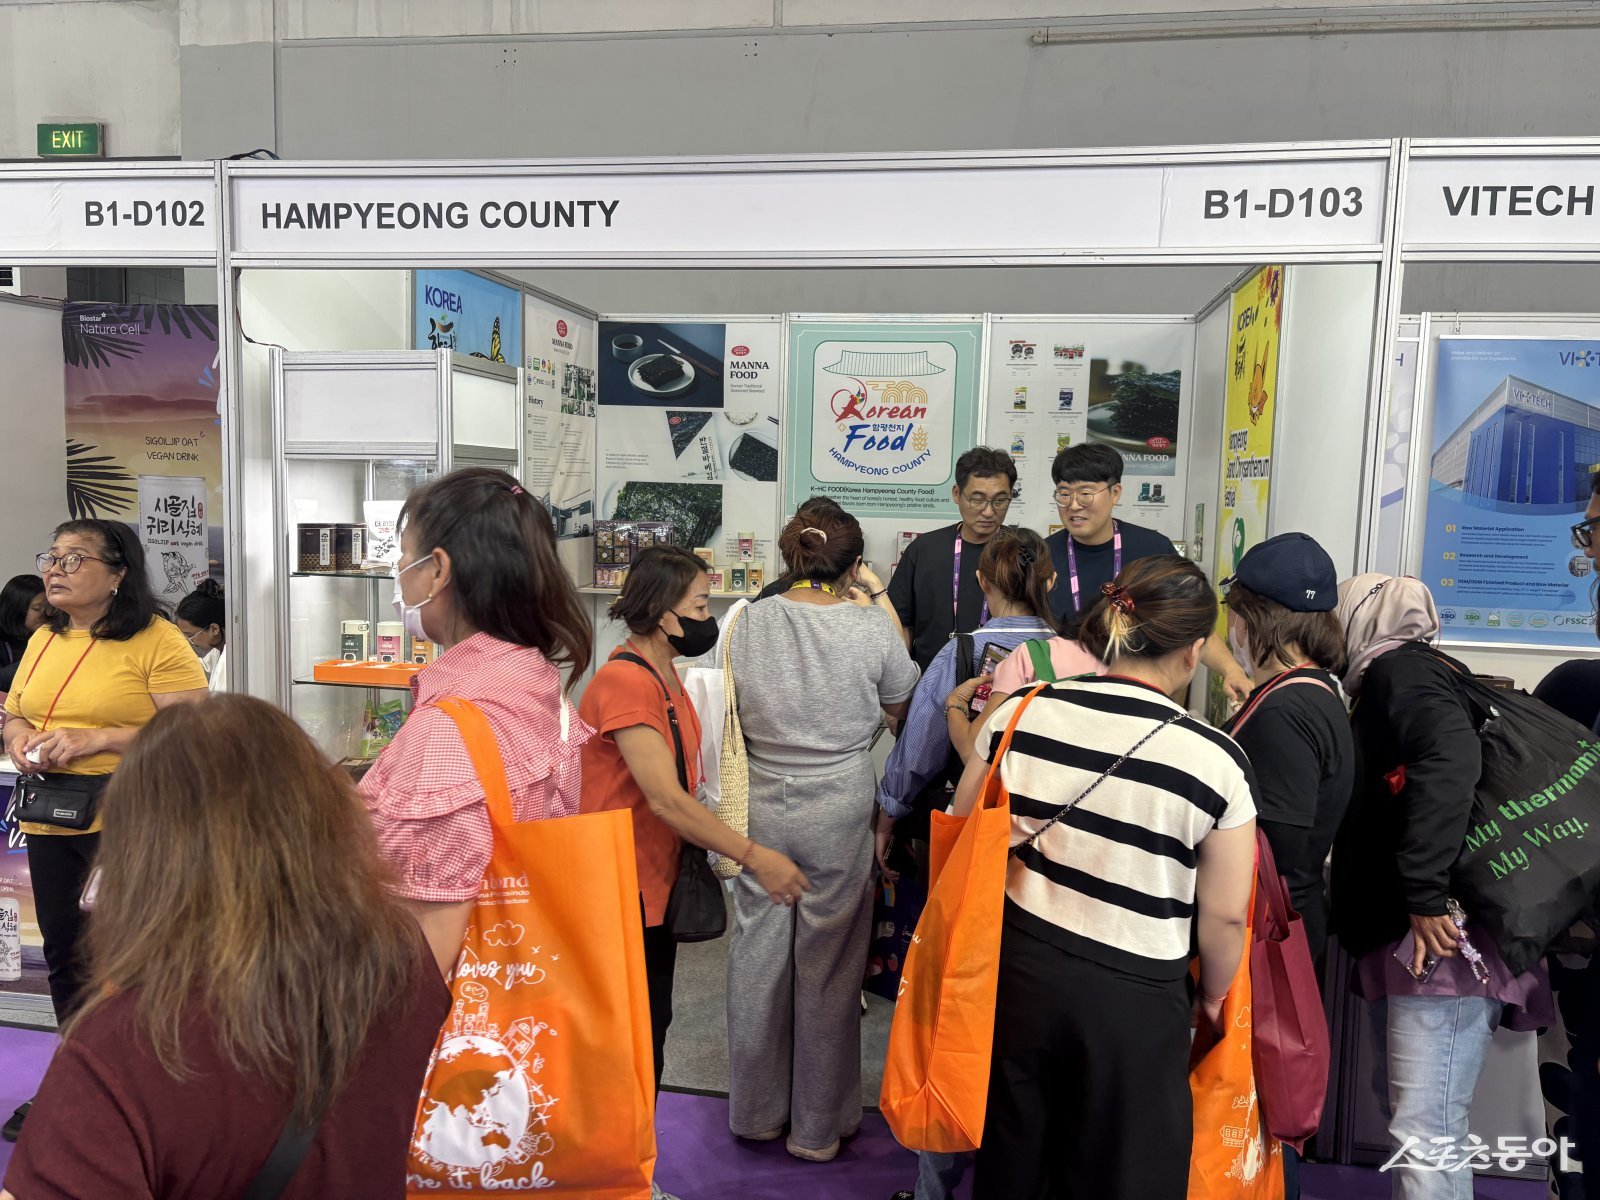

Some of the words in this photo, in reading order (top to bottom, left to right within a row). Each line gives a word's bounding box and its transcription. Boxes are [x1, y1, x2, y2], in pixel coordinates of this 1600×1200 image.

[52, 130, 84, 149] EXIT
[84, 200, 206, 227] B1-D102
[261, 202, 470, 230] HAMPYEONG
[480, 200, 620, 228] COUNTY
[1204, 186, 1364, 220] B1-D103
[1442, 186, 1595, 216] VITECH
[425, 284, 463, 314] KOREA
[80, 324, 116, 334] Nature
[120, 324, 140, 335] Cell
[730, 361, 770, 370] MANNA
[730, 371, 758, 379] FOOD
[182, 438, 198, 446] OAT
[843, 422, 914, 453] Food
[872, 424, 904, 432] 함평천지
[146, 452, 174, 460] VEGAN
[176, 452, 199, 461] DRINK
[829, 447, 889, 476] HAMPYEONG
[892, 449, 932, 475] COUNTY
[154, 495, 197, 518] 시골집
[1443, 552, 1456, 560] 02
[1465, 820, 1502, 852] My
[1487, 846, 1530, 880] My
[1522, 817, 1589, 848] Way.
[455, 950, 501, 980] loves
[480, 1161, 556, 1190] back
